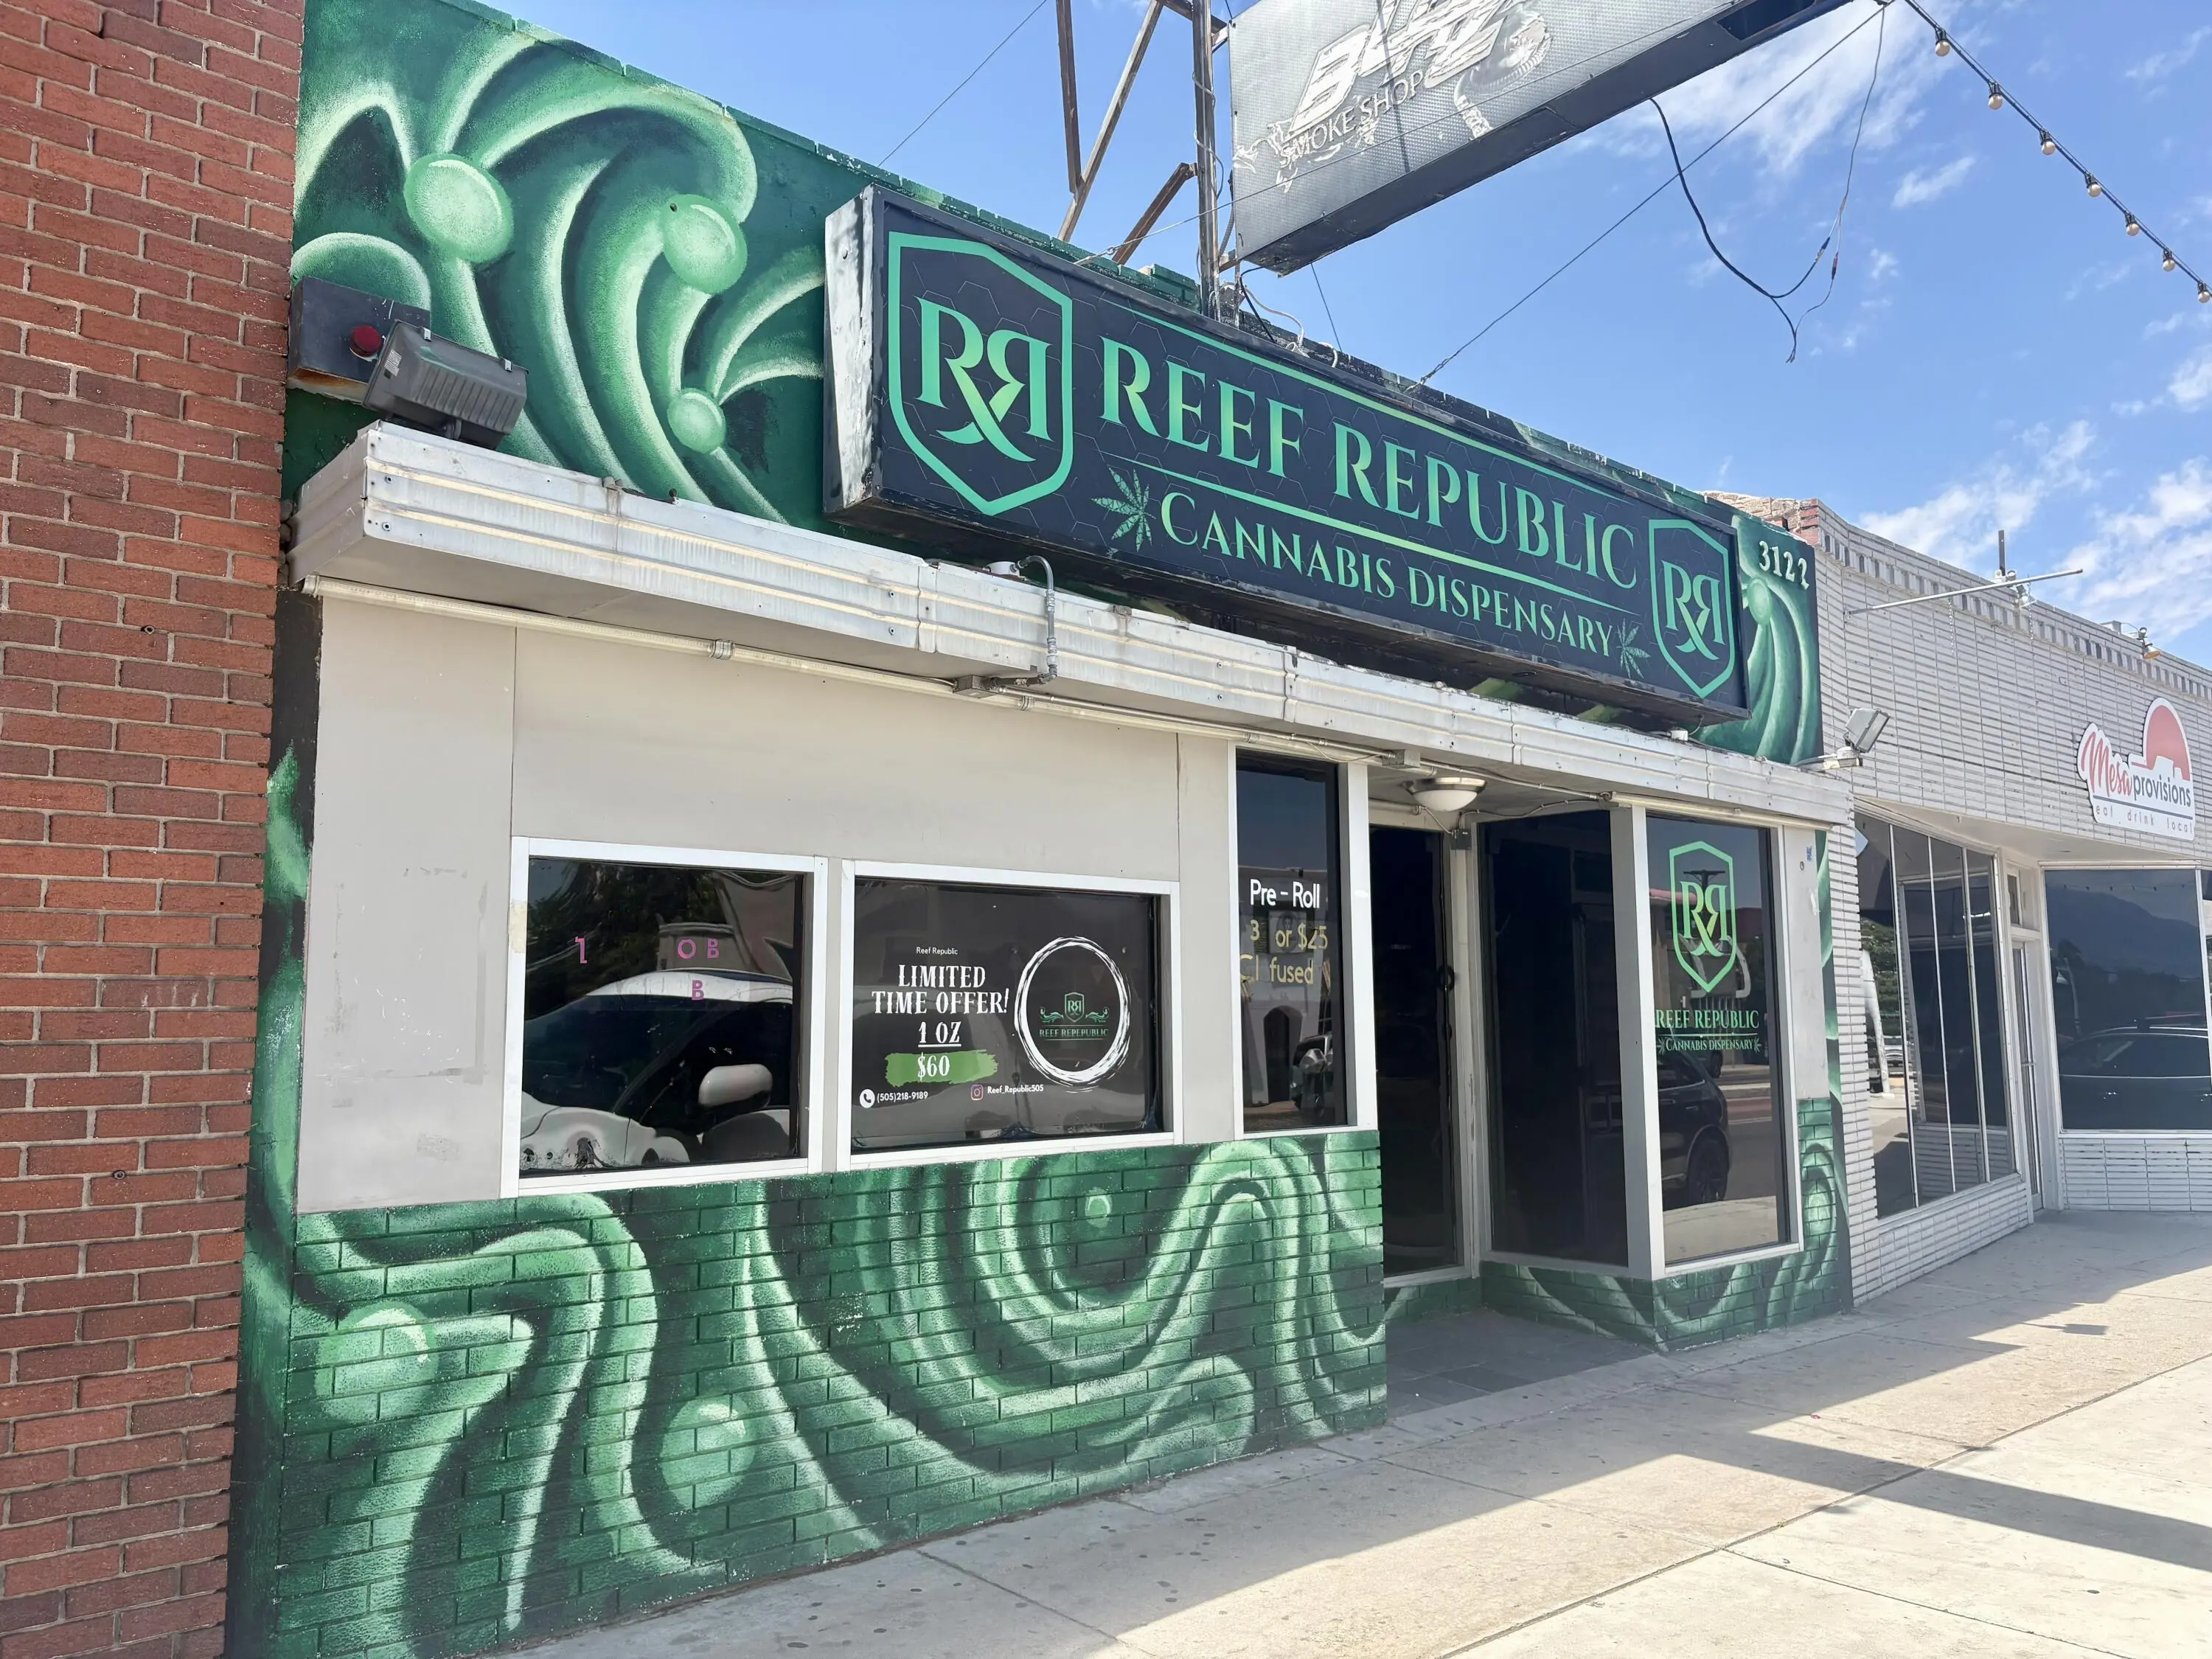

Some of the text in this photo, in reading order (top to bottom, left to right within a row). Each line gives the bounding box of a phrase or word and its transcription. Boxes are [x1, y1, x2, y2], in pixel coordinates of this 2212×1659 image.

[1279, 69, 1425, 168] SMOKE SHOP
[1099, 335, 1637, 588] REEF REPUBLIC
[1161, 492, 1613, 657] CANNABIS DISPENSARY
[2081, 731, 2191, 807] Mesa provisions
[2127, 808, 2154, 826] drink
[2166, 817, 2192, 834] local
[1250, 878, 1277, 906] Pre
[1293, 881, 1320, 908] Roll
[1298, 922, 1328, 950] $25
[916, 946, 958, 956] Reef Republic
[898, 964, 986, 988] LIMITED
[872, 987, 1009, 1015] TIME OFFER!
[1655, 1009, 1759, 1029] REEF REPUBLIC
[919, 1021, 961, 1044] 1 OZ
[1039, 1029, 1059, 1037] REEF
[1666, 1037, 1753, 1051] CANNABIS DISPENSARY
[917, 1052, 950, 1082] $60
[877, 1091, 928, 1103] (505)218-9189
[987, 1084, 1044, 1095] Reef_Republic505
